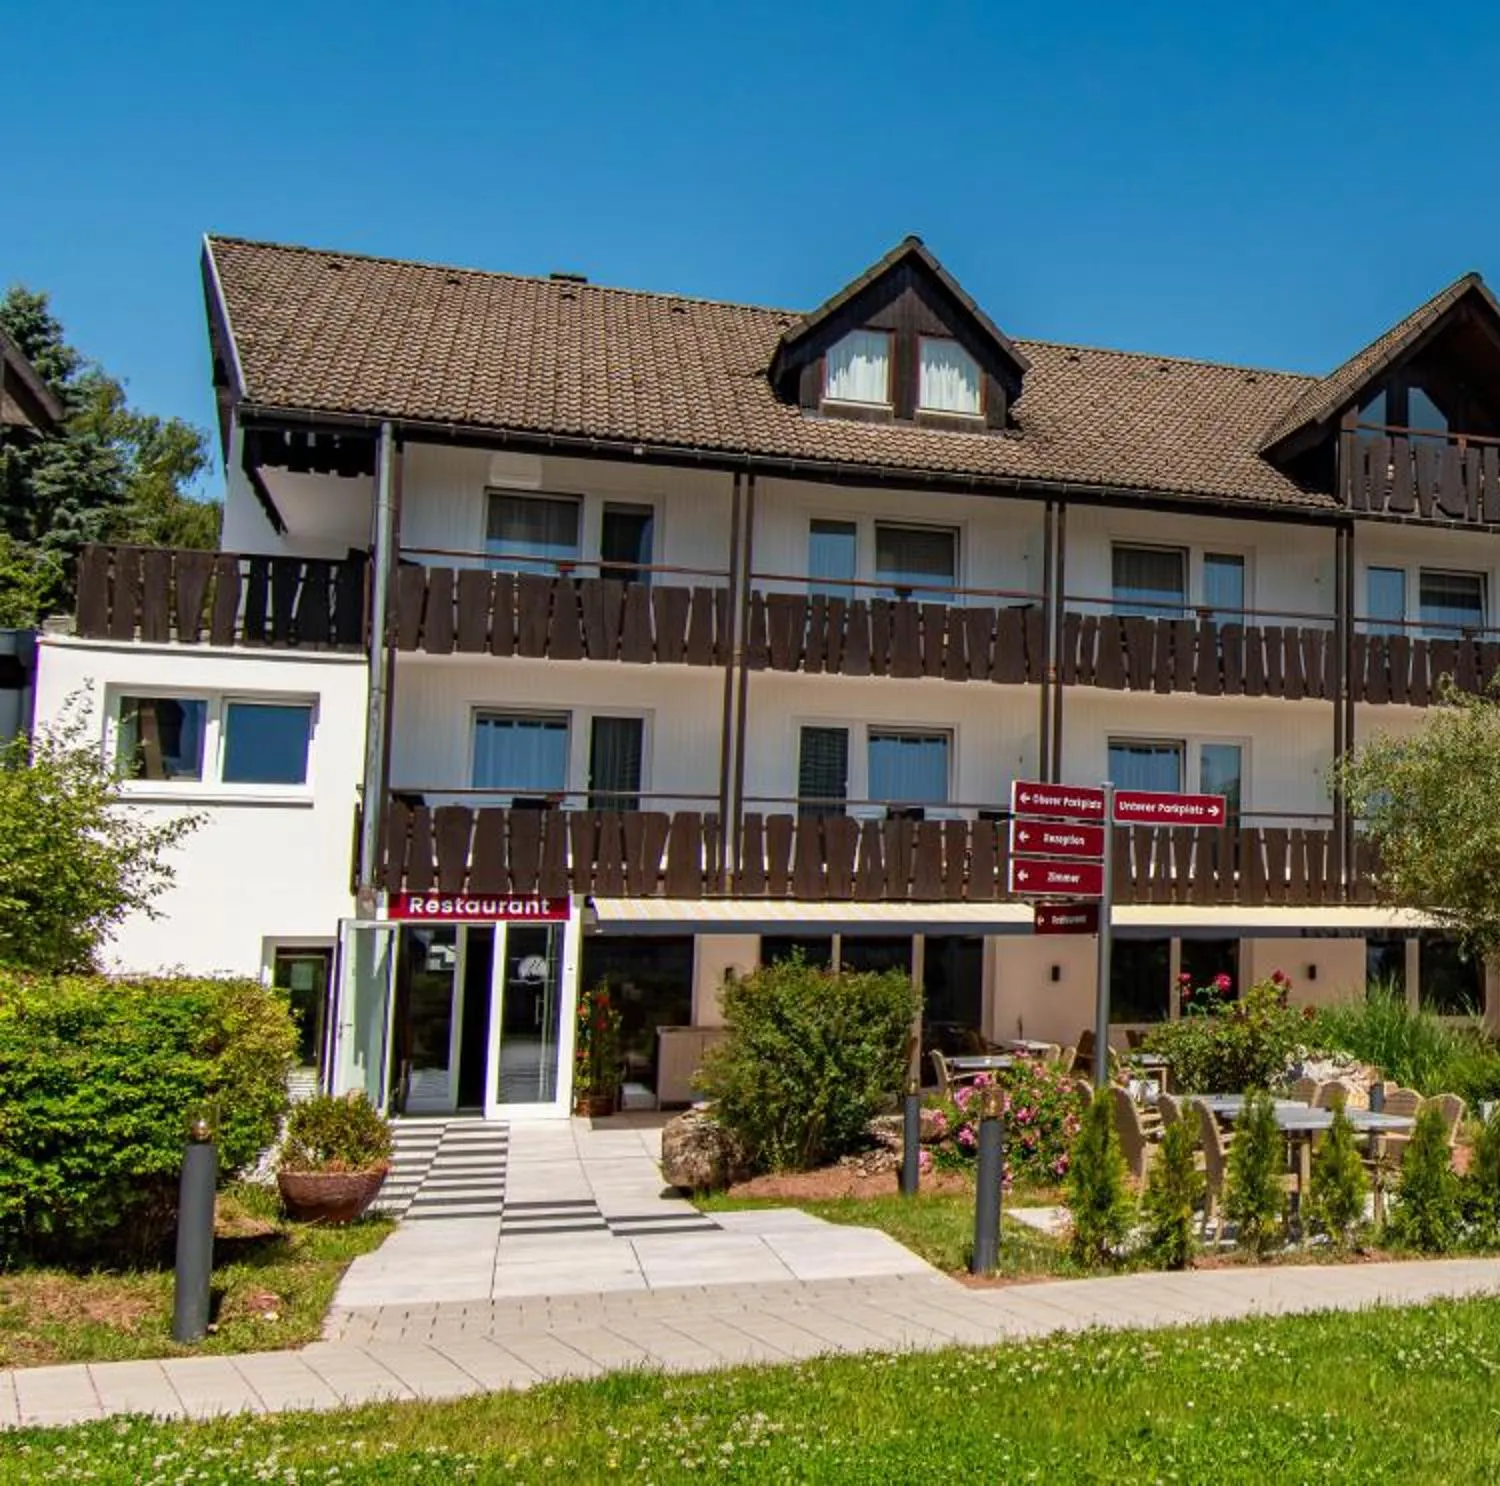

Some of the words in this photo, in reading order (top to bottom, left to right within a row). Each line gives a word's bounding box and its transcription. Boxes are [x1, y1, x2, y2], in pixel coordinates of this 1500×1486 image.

[1032, 794, 1061, 806] Oberer
[1063, 796, 1102, 811] Parkplatz
[1119, 801, 1156, 812] Unterer
[1158, 803, 1204, 816] Parkplatz
[1047, 871, 1081, 884] Zimmer
[409, 896, 551, 915] Restaurant
